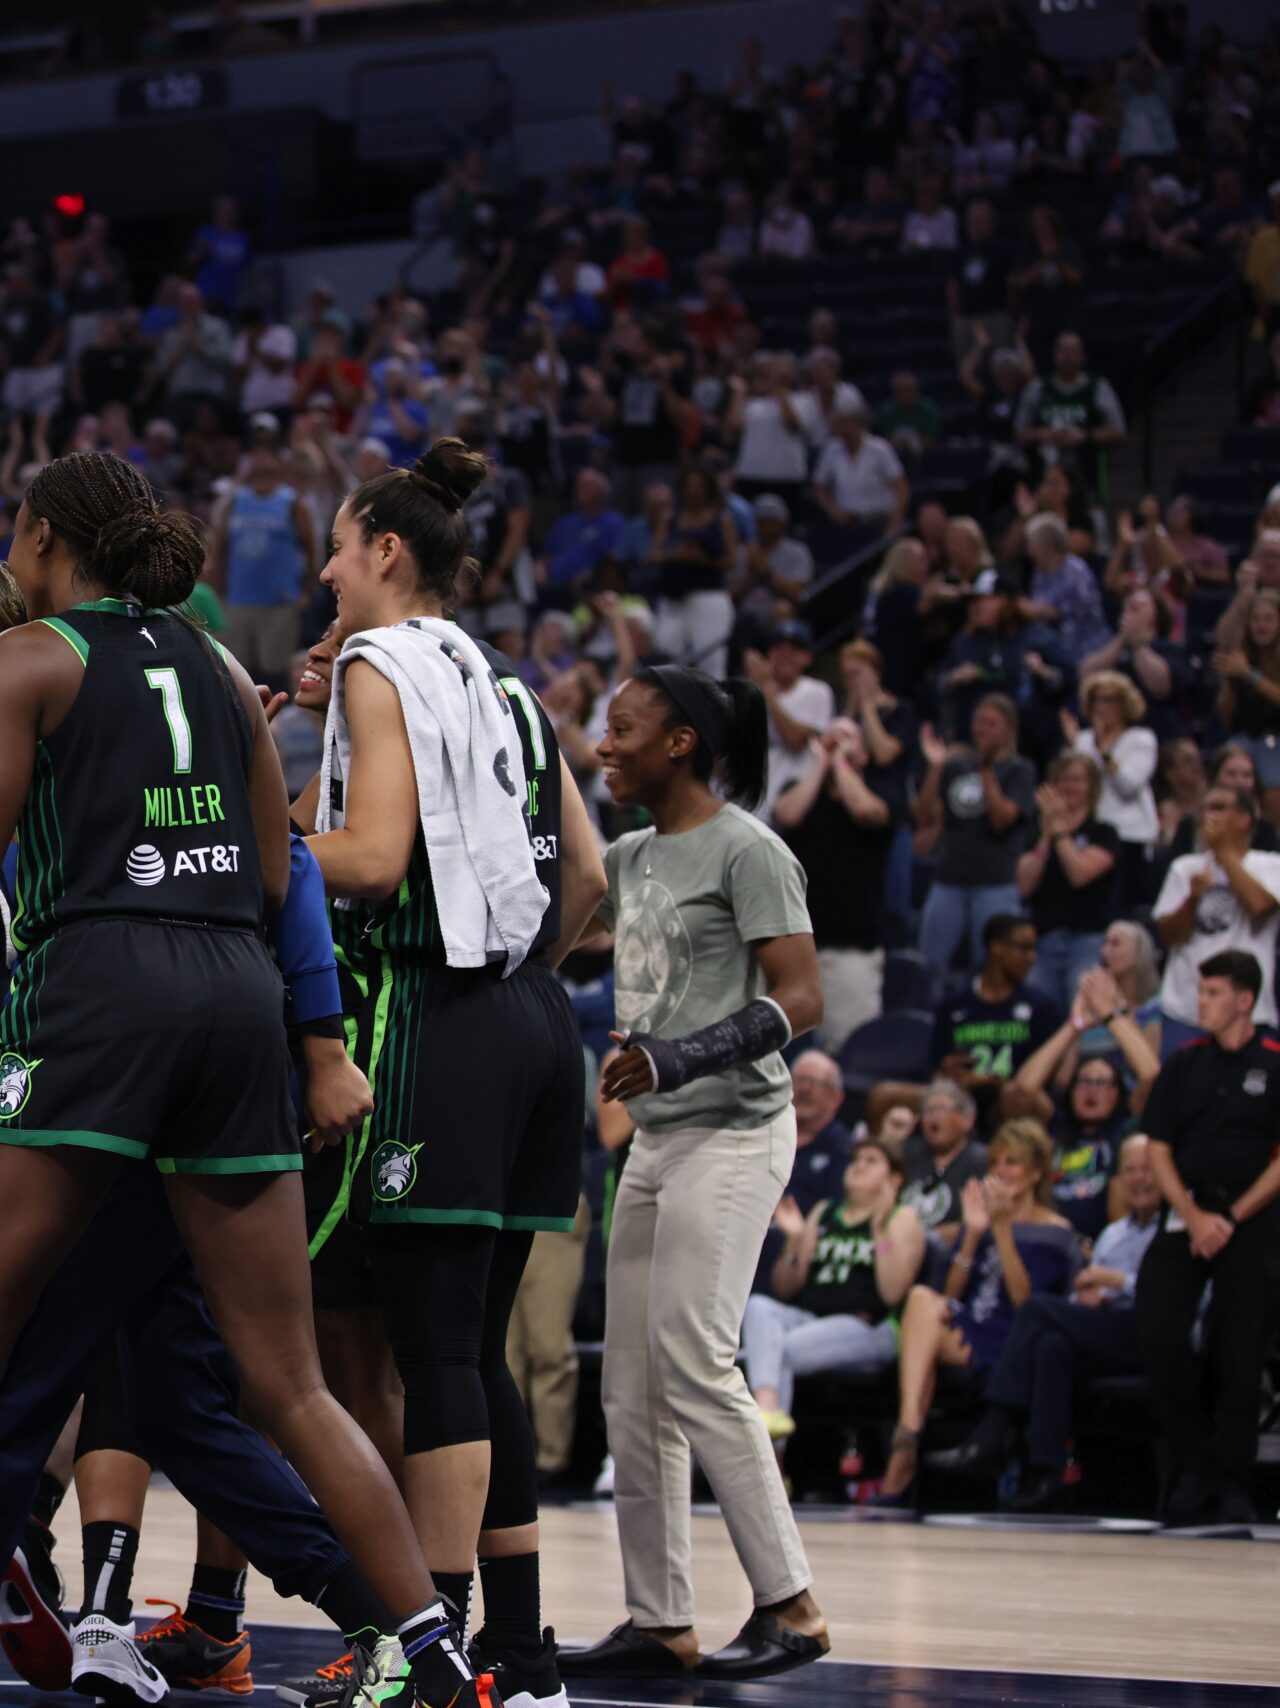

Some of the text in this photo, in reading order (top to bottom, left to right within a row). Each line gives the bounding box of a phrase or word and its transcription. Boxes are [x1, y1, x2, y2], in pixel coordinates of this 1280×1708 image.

[144, 667, 193, 774] 1
[144, 784, 226, 828] MILLER
[173, 845, 240, 877] AT&T
[532, 835, 557, 861] &T
[818, 1236, 875, 1265] YNX
